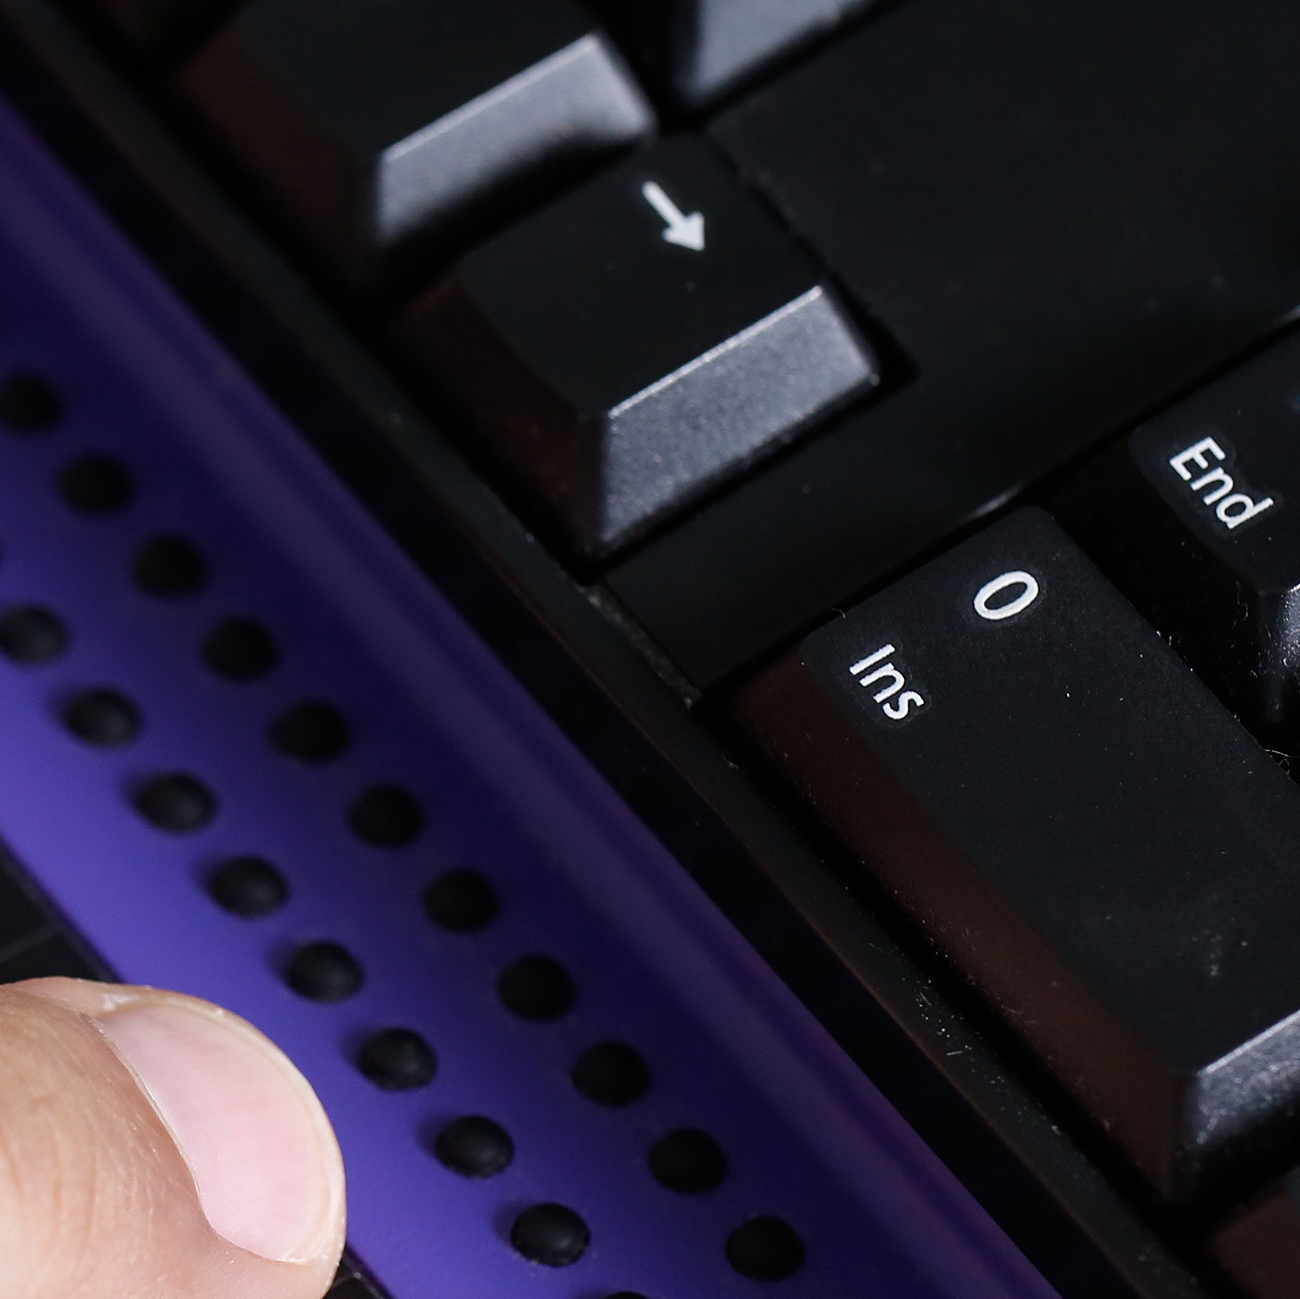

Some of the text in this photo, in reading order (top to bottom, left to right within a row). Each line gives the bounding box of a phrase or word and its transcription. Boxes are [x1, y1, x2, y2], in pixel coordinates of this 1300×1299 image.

[1168, 435, 1275, 531] End
[973, 569, 1040, 621] 0
[848, 642, 926, 721] Ins
